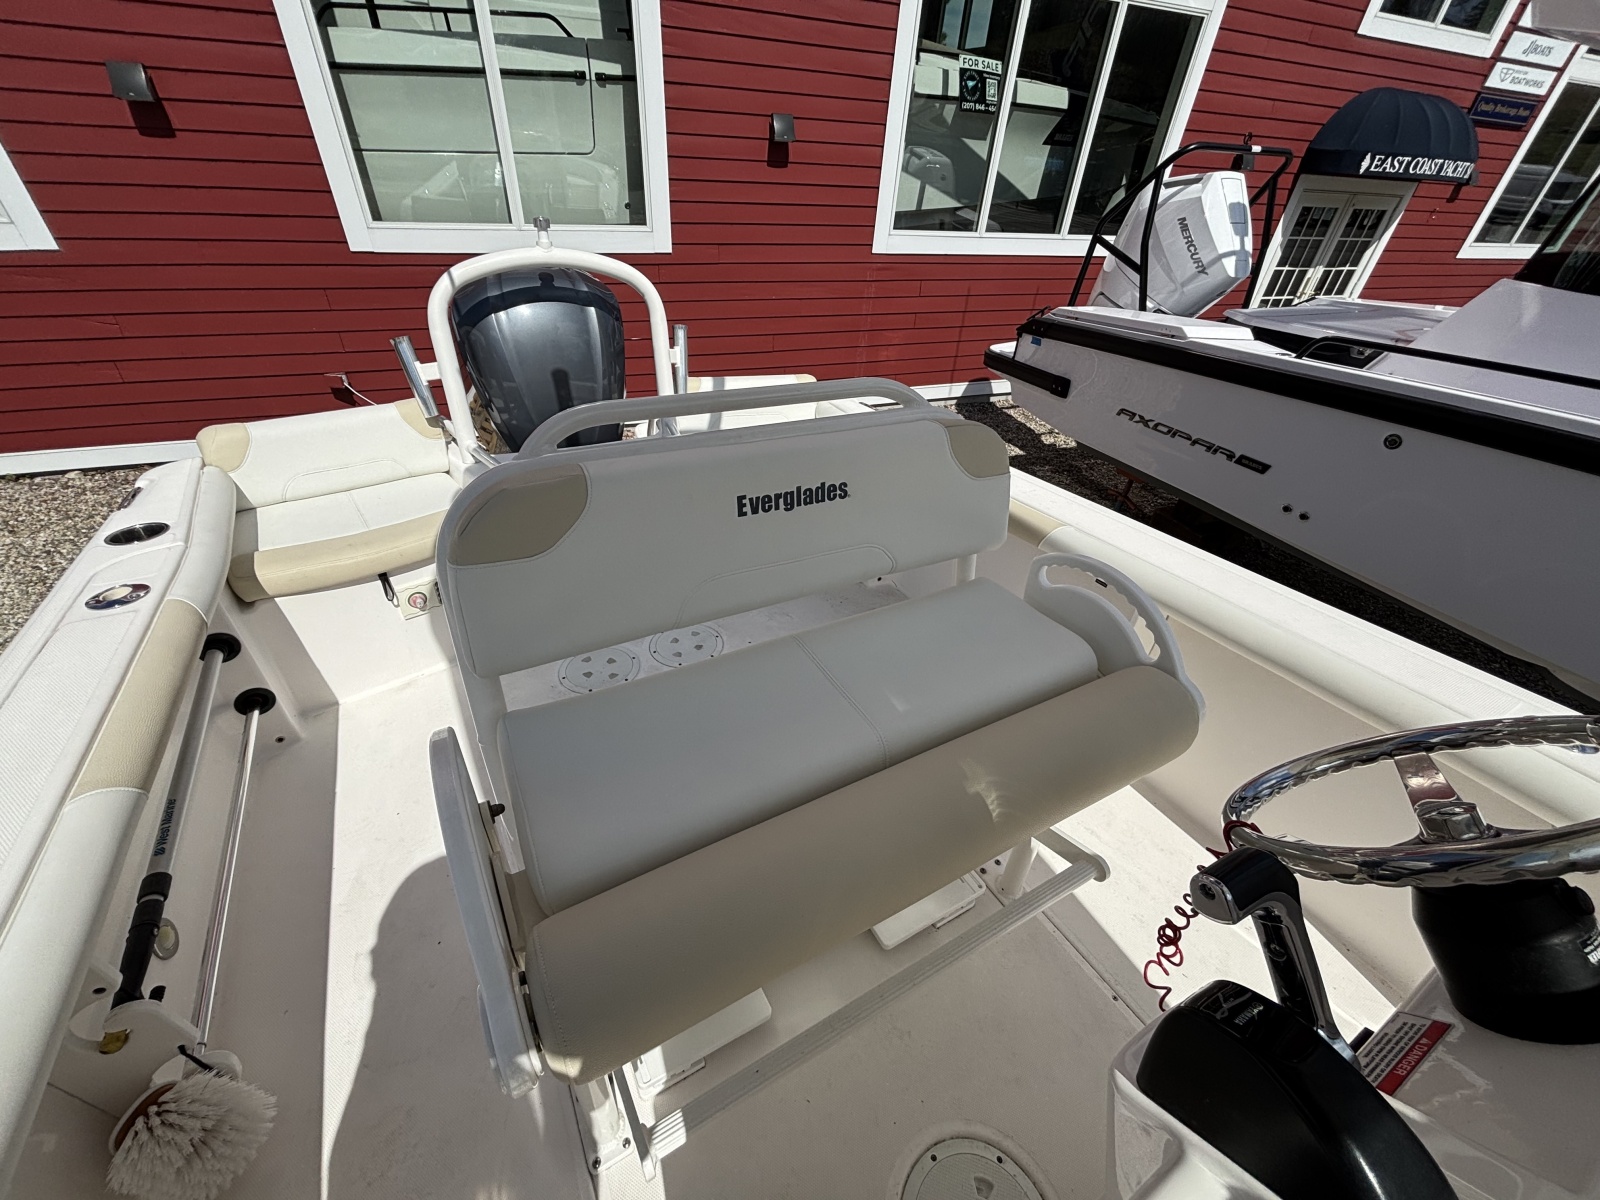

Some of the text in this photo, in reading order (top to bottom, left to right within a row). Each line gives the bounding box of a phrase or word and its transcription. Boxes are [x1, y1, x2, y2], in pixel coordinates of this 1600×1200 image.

[962, 57, 999, 72] FOR SALE
[961, 102, 974, 111] (207)
[1369, 155, 1411, 173] EAST
[1409, 157, 1444, 176] COAST
[1177, 216, 1209, 276] MERCURY
[1115, 407, 1236, 463] AXOPAR
[736, 481, 849, 518] Everglades
[155, 824, 171, 849] West
[1393, 1044, 1428, 1076] DANGER
